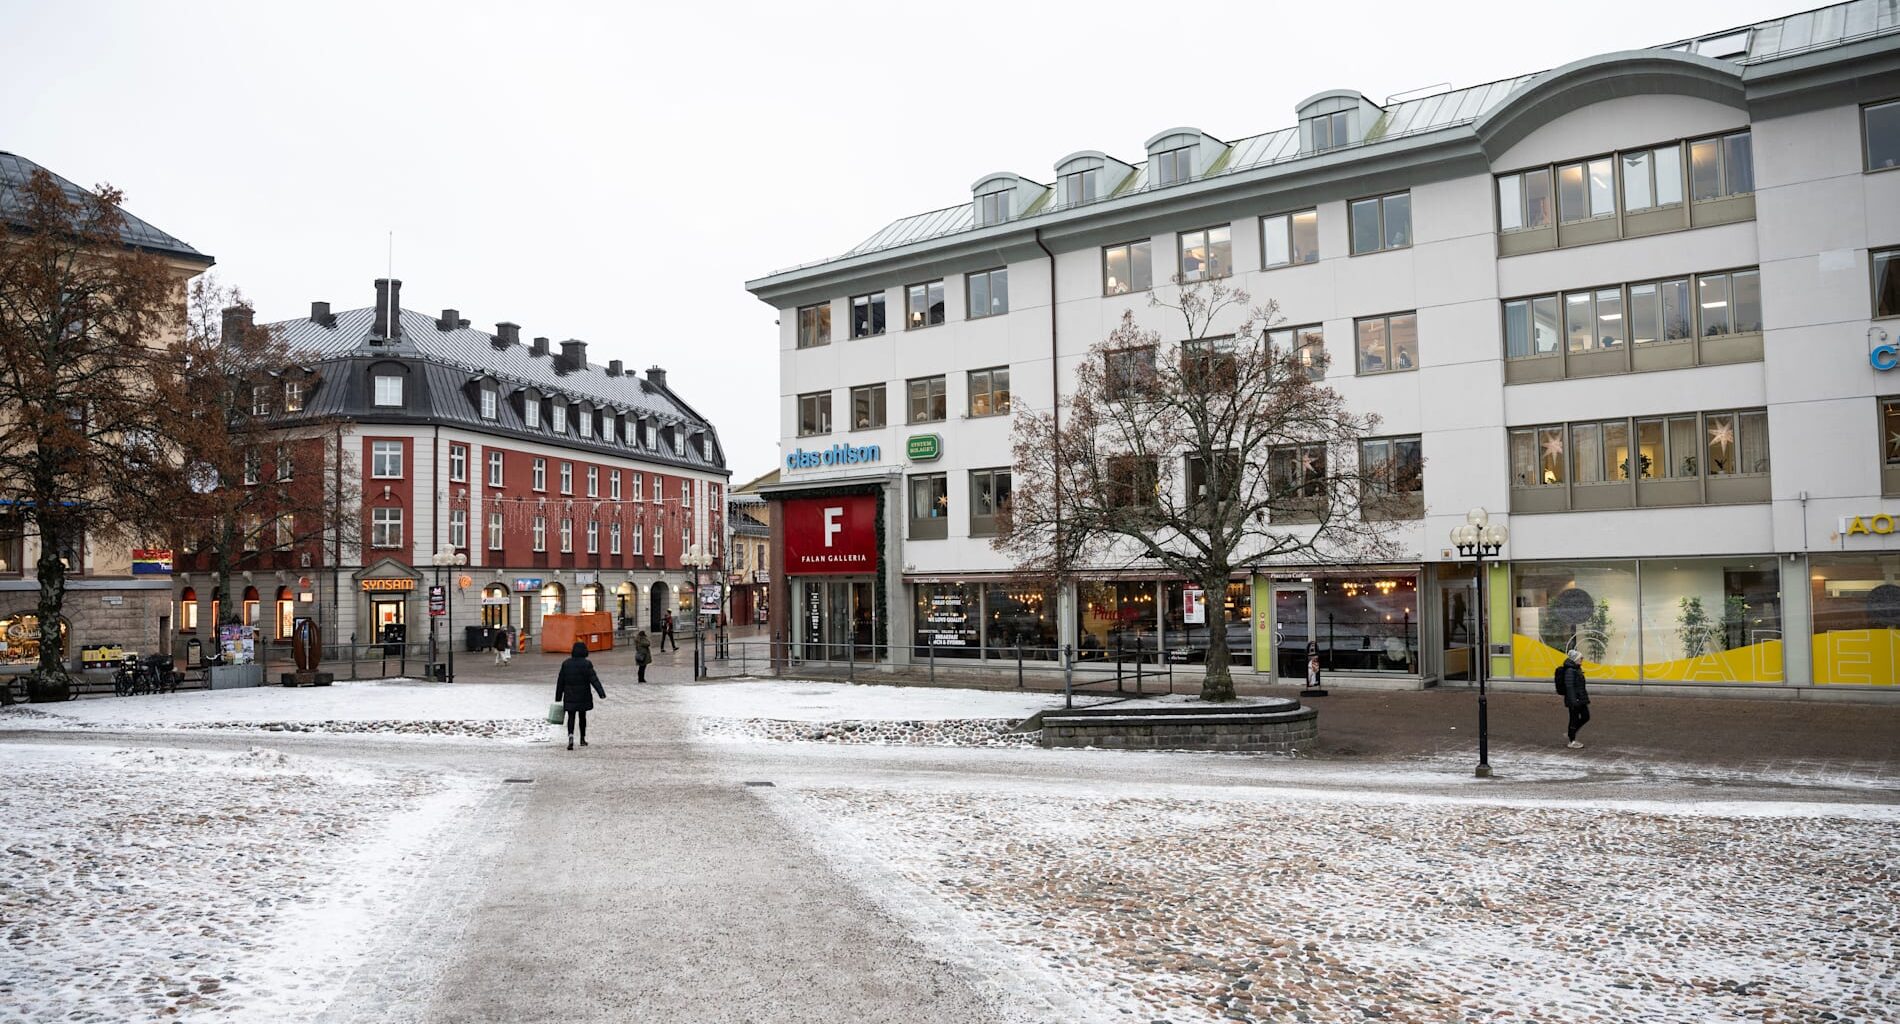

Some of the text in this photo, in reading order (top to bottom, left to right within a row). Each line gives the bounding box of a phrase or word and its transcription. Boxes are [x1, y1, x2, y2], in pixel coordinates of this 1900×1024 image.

[1871, 340, 1900, 370] C
[786, 443, 880, 469] clas ohlson
[824, 507, 843, 547] F
[361, 579, 414, 590] SYNSAM
